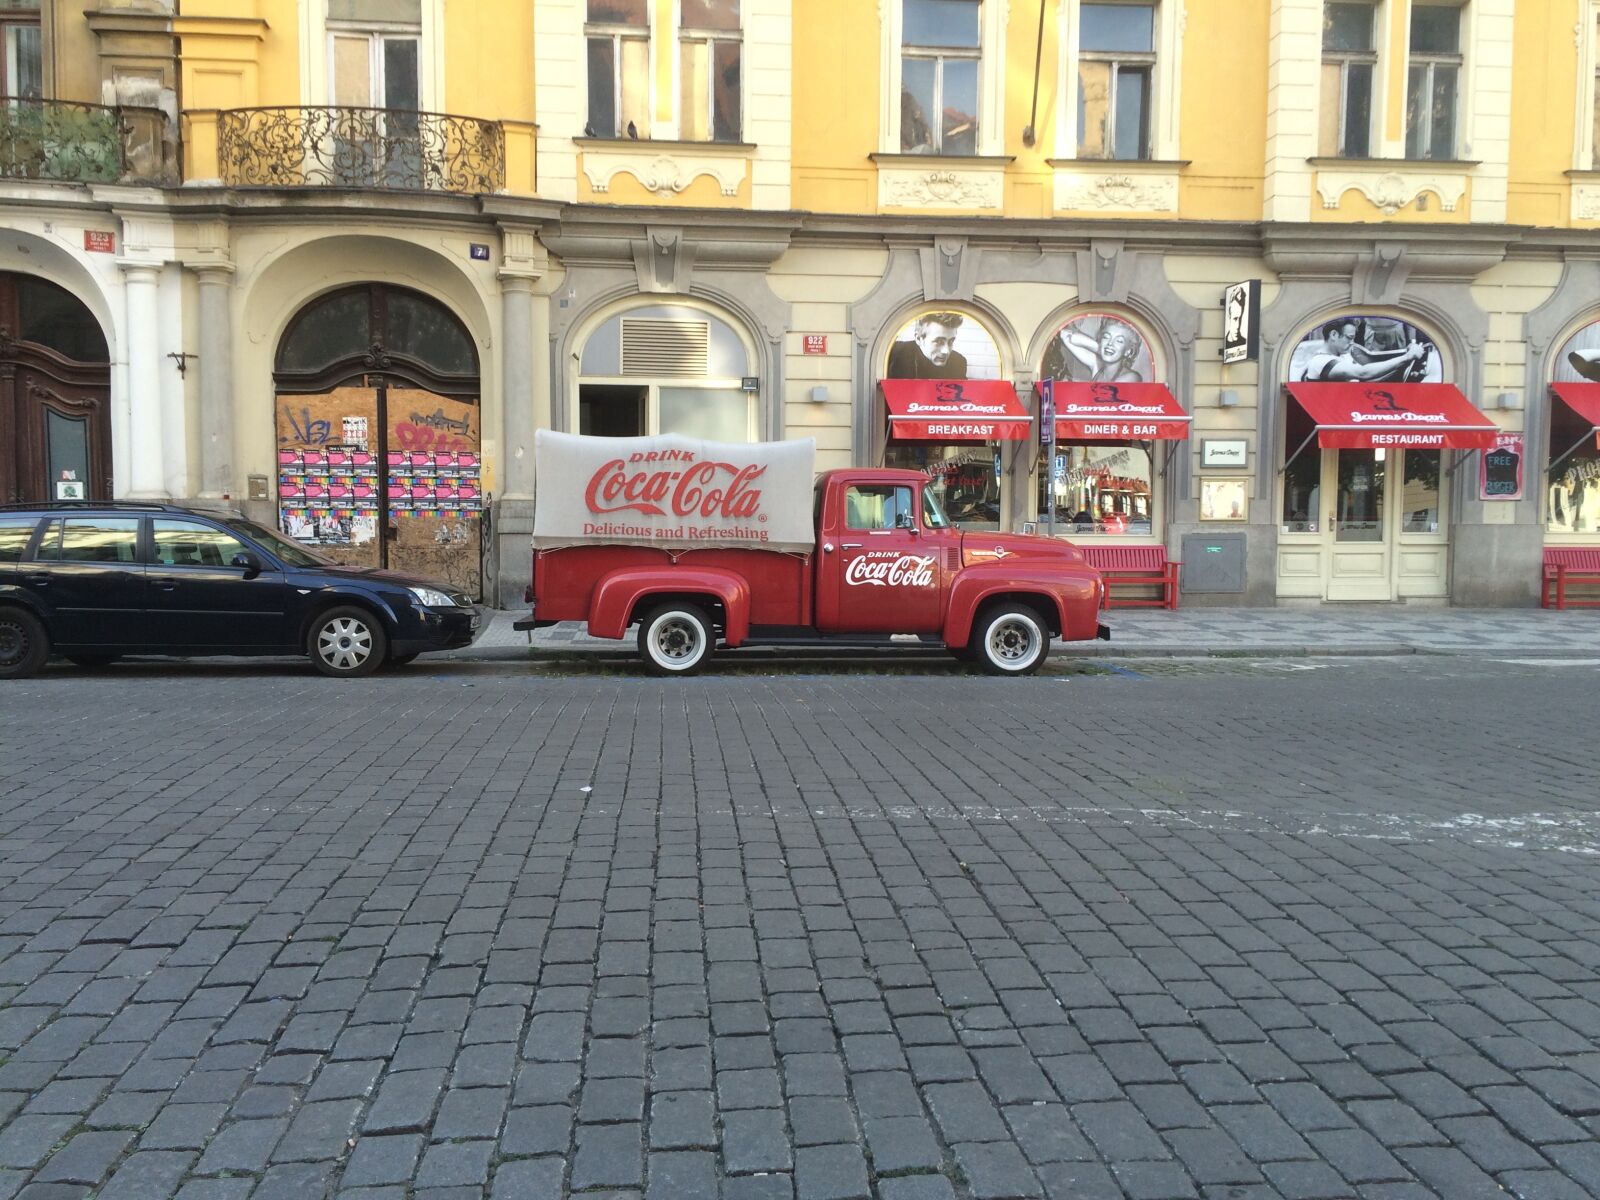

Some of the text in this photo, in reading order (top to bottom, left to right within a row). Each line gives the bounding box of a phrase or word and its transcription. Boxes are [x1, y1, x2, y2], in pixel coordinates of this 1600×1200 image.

[91, 231, 109, 241] 923
[477, 247, 483, 257] 7
[808, 336, 823, 345] 922
[907, 402, 960, 413] James
[960, 403, 1003, 413] Dean
[1066, 403, 1118, 413] James
[1118, 403, 1163, 413] Dean
[1351, 411, 1446, 422] James Dean
[928, 425, 995, 435] BREAKFAST
[1084, 425, 1157, 434] DINER & BAR
[1371, 434, 1444, 444] RESTAURANT
[629, 449, 696, 463] DRINK
[1488, 456, 1512, 466] FREE
[584, 458, 769, 518] Coca-Cola
[583, 522, 769, 542] Delicious and Refreshing
[845, 555, 936, 587] Coca-Cola
